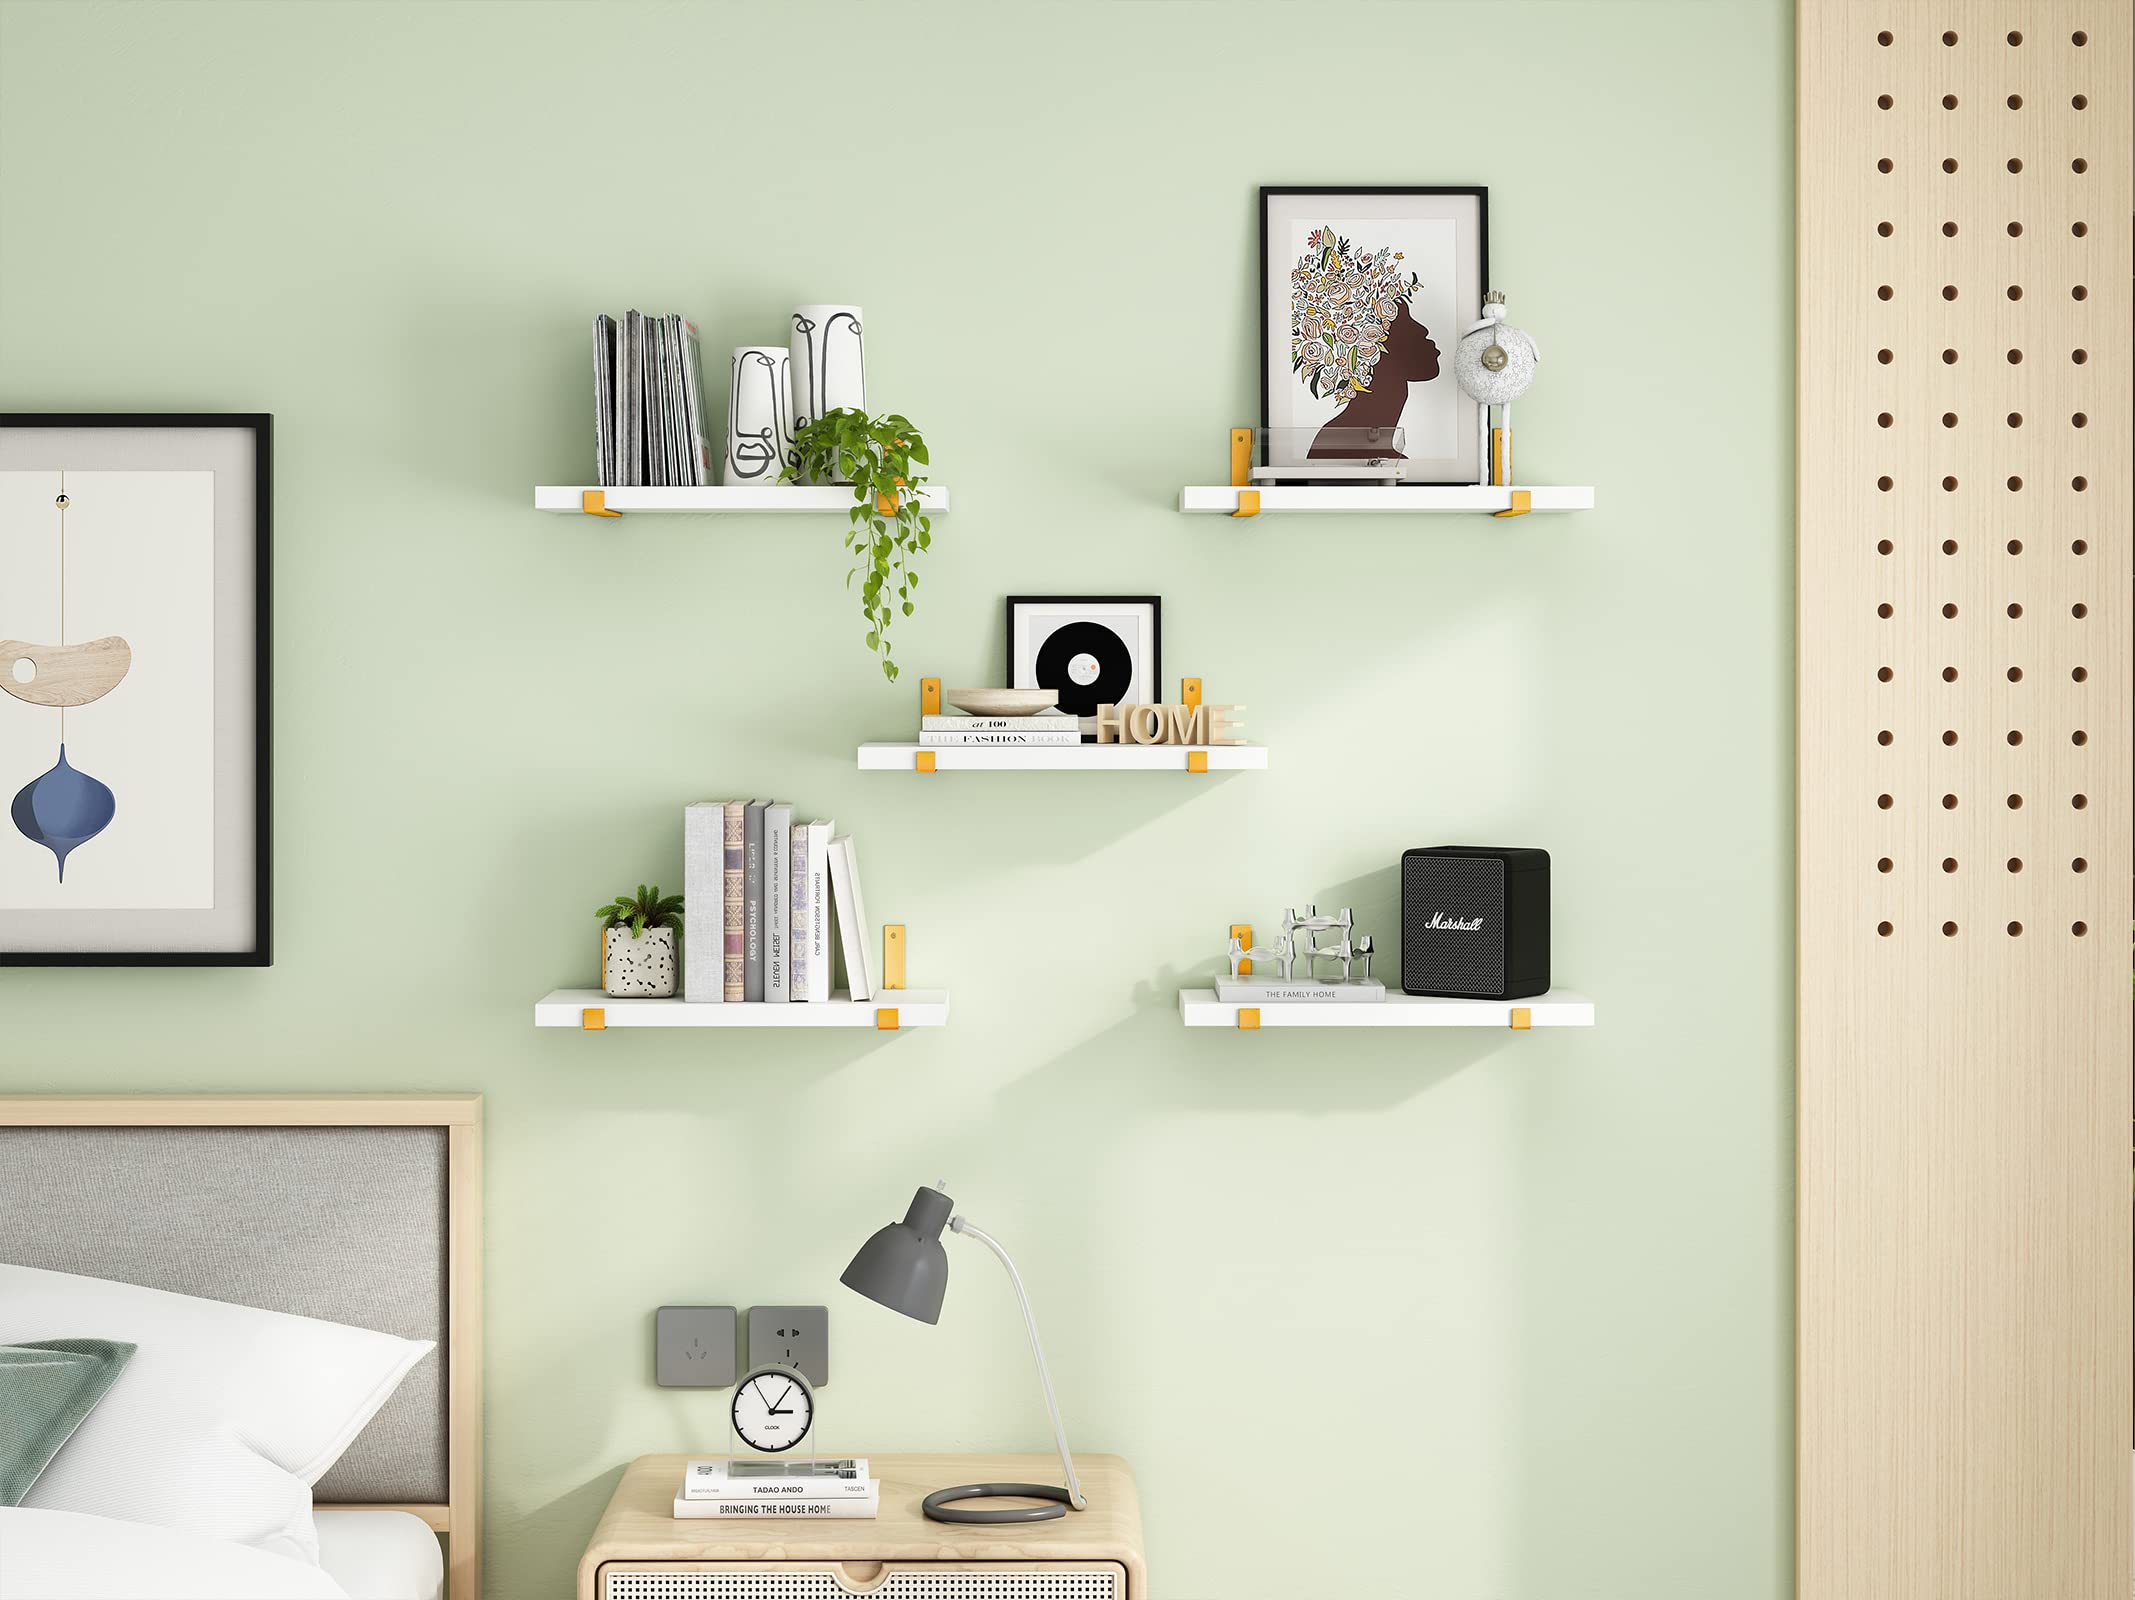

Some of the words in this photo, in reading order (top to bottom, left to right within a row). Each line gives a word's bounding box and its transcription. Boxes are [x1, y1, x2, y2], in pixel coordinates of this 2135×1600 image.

[1097, 703, 1248, 745] HOME
[963, 735, 1027, 743] FASHION
[1425, 911, 1483, 931] Marshall
[749, 900, 757, 962] PSYCHOLOGY
[753, 1486, 780, 1494] TADAO
[781, 1486, 804, 1494] ANDO
[719, 1504, 759, 1515] BRINGING
[760, 1504, 777, 1515] THE
[779, 1504, 806, 1515] HOUSE
[807, 1504, 831, 1515] HOME
